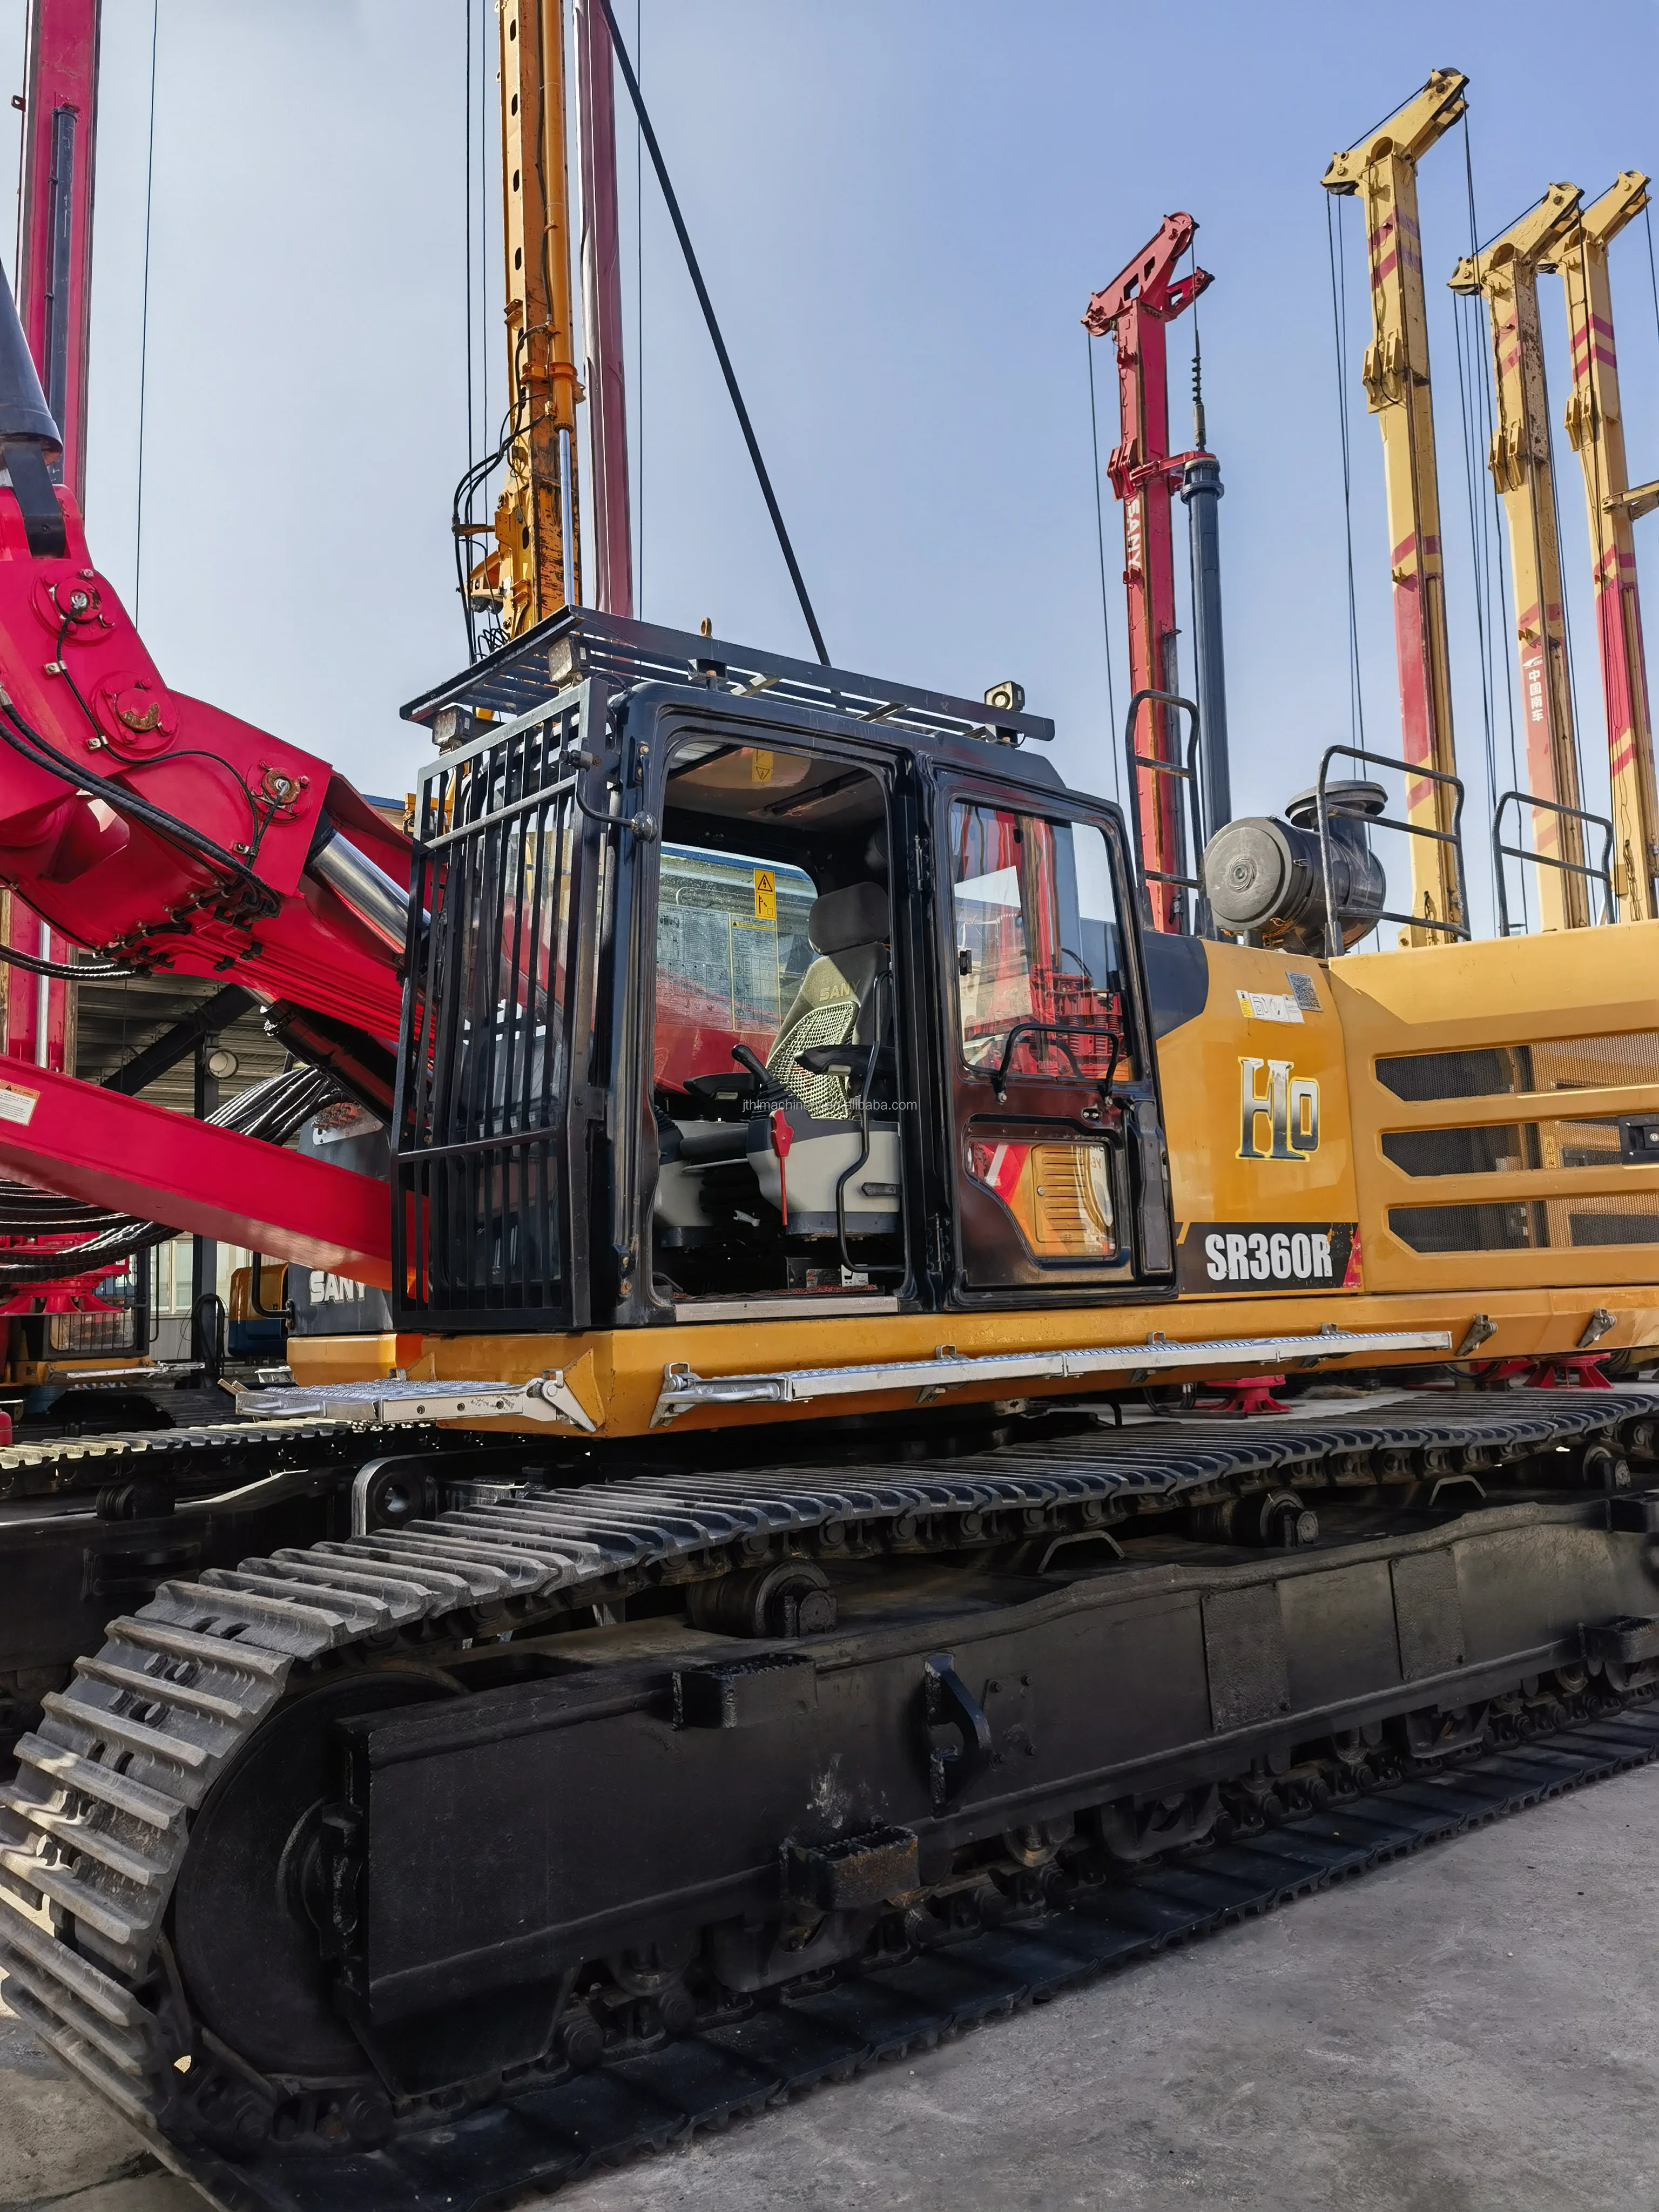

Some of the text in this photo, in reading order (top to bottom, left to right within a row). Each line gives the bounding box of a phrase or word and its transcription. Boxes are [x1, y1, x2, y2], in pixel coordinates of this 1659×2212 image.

[1127, 499, 1141, 567] SANY
[1529, 669, 1543, 721] 中国南车
[819, 978, 861, 1001] SANY
[1205, 1233, 1333, 1280] SR360R
[309, 1270, 366, 1305] SANY
